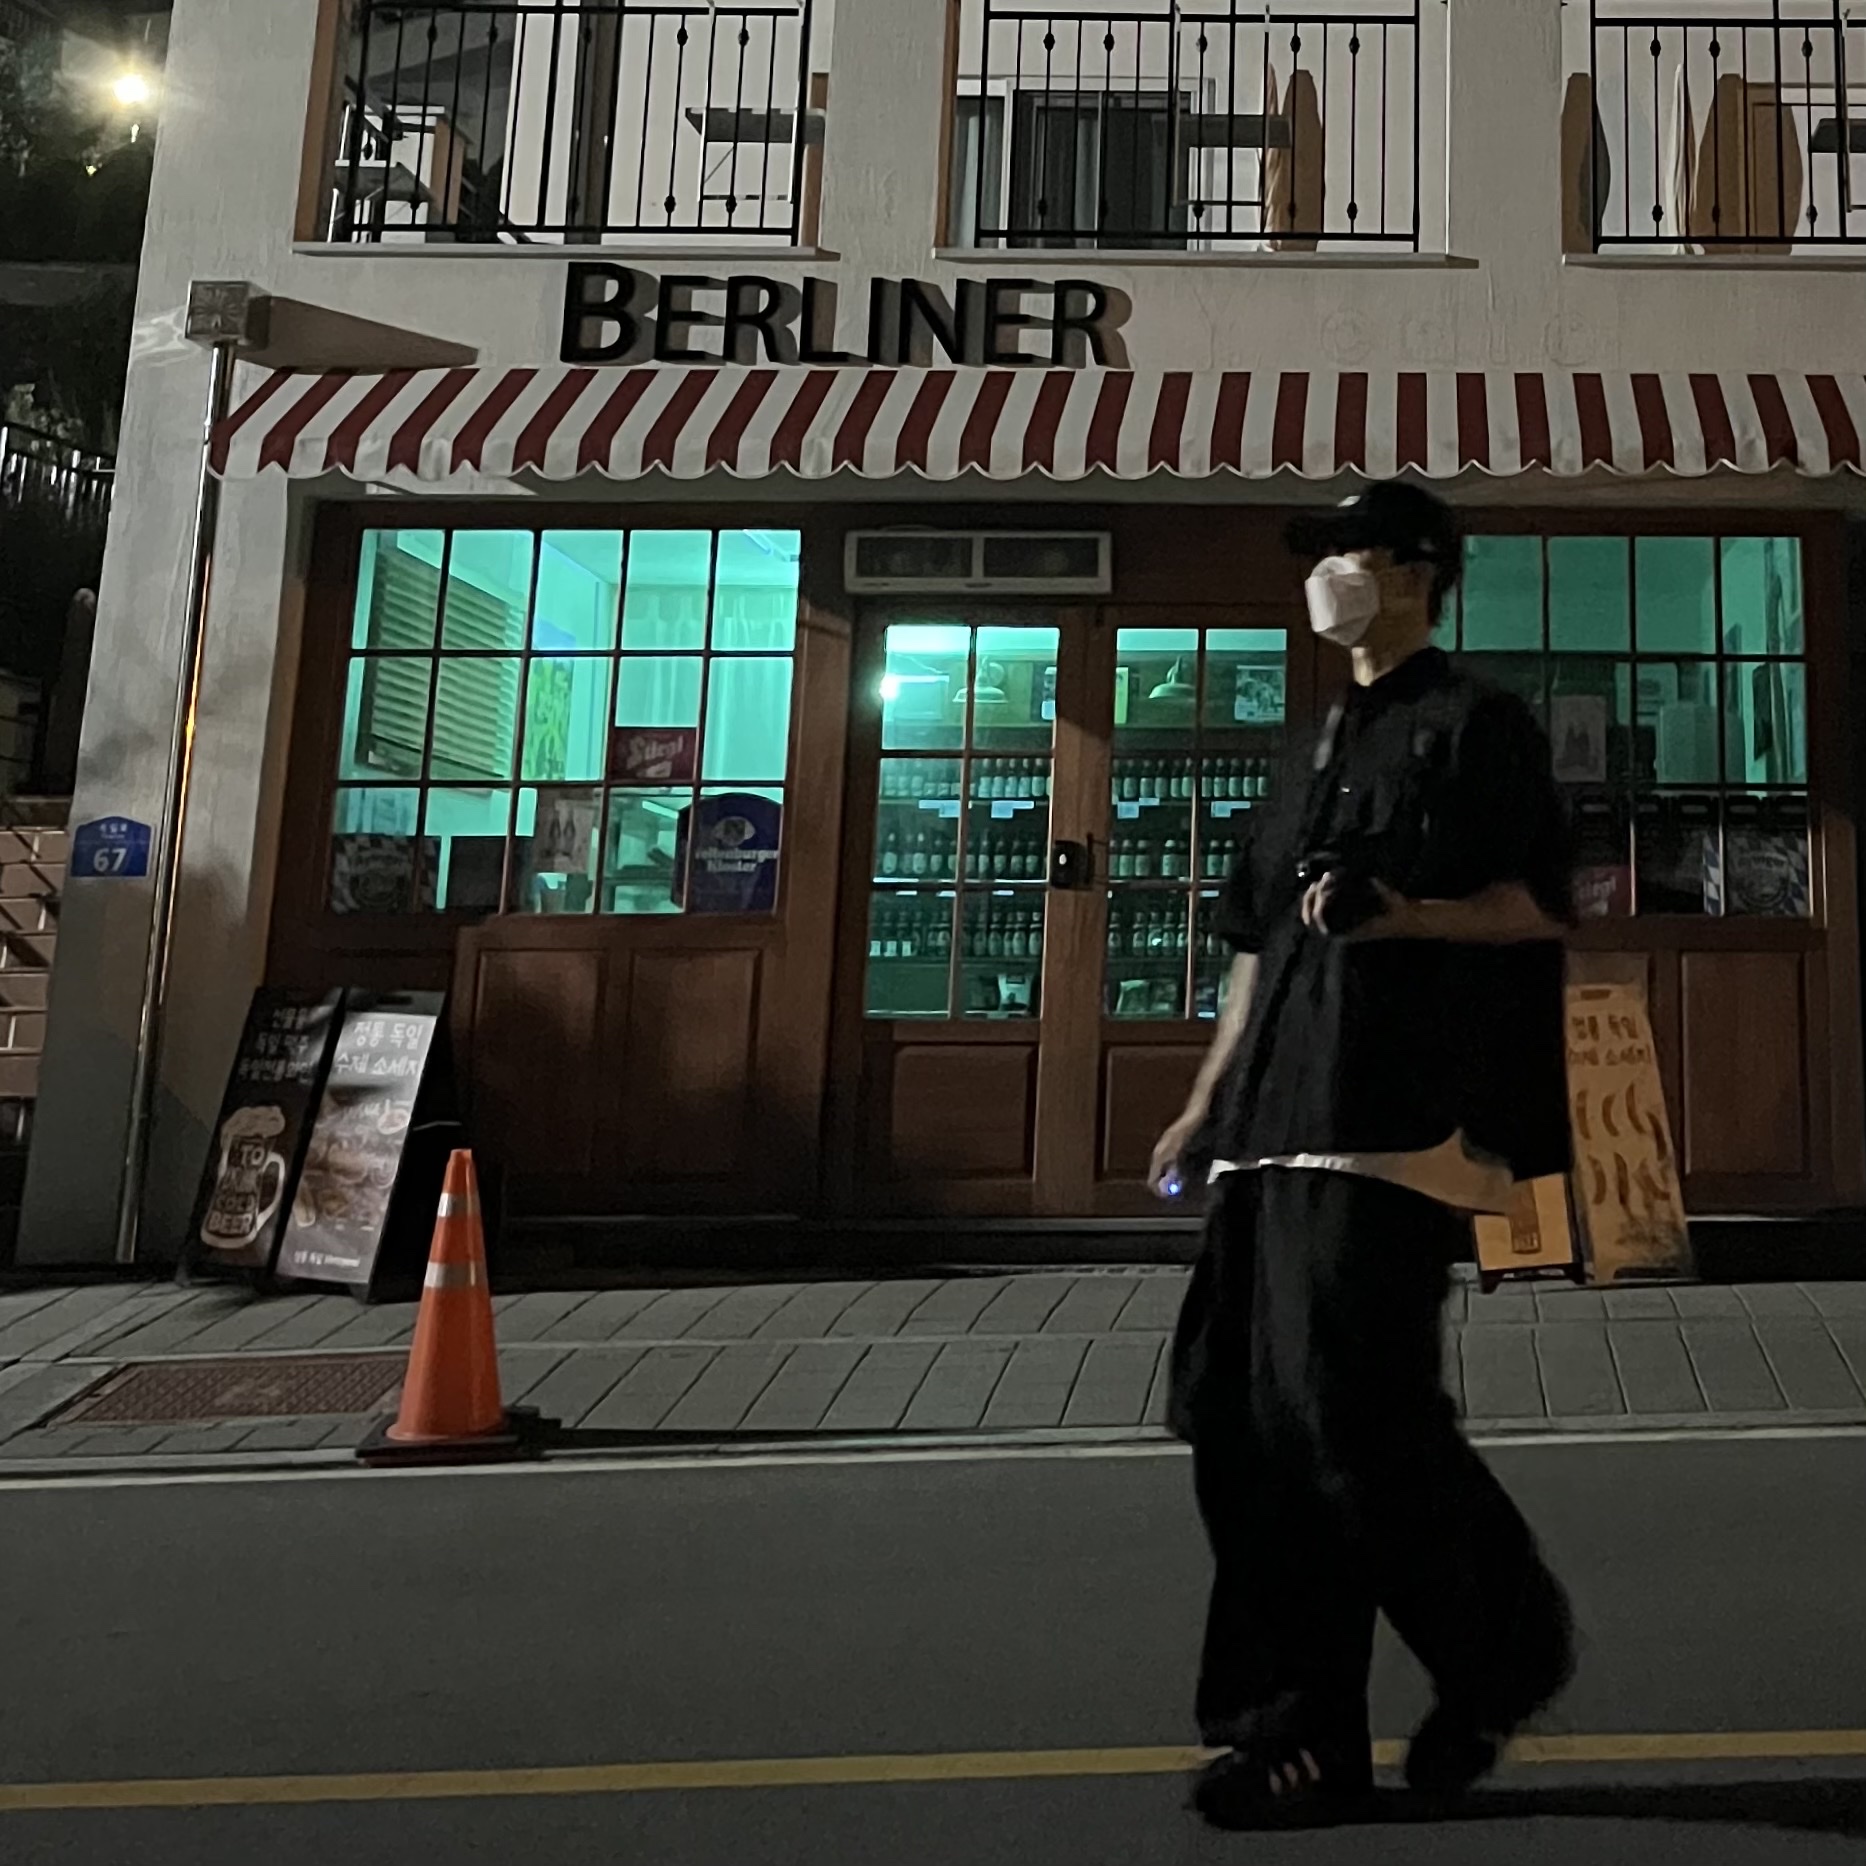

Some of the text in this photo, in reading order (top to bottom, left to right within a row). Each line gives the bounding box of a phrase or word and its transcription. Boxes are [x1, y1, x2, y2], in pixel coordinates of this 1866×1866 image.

[560, 261, 1112, 365] BERLINER
[93, 847, 127, 873] 67
[353, 1020, 424, 1050] 정통 독일
[335, 1052, 370, 1075] 수제
[240, 1143, 266, 1167] TO
[206, 1210, 254, 1236] BEER
